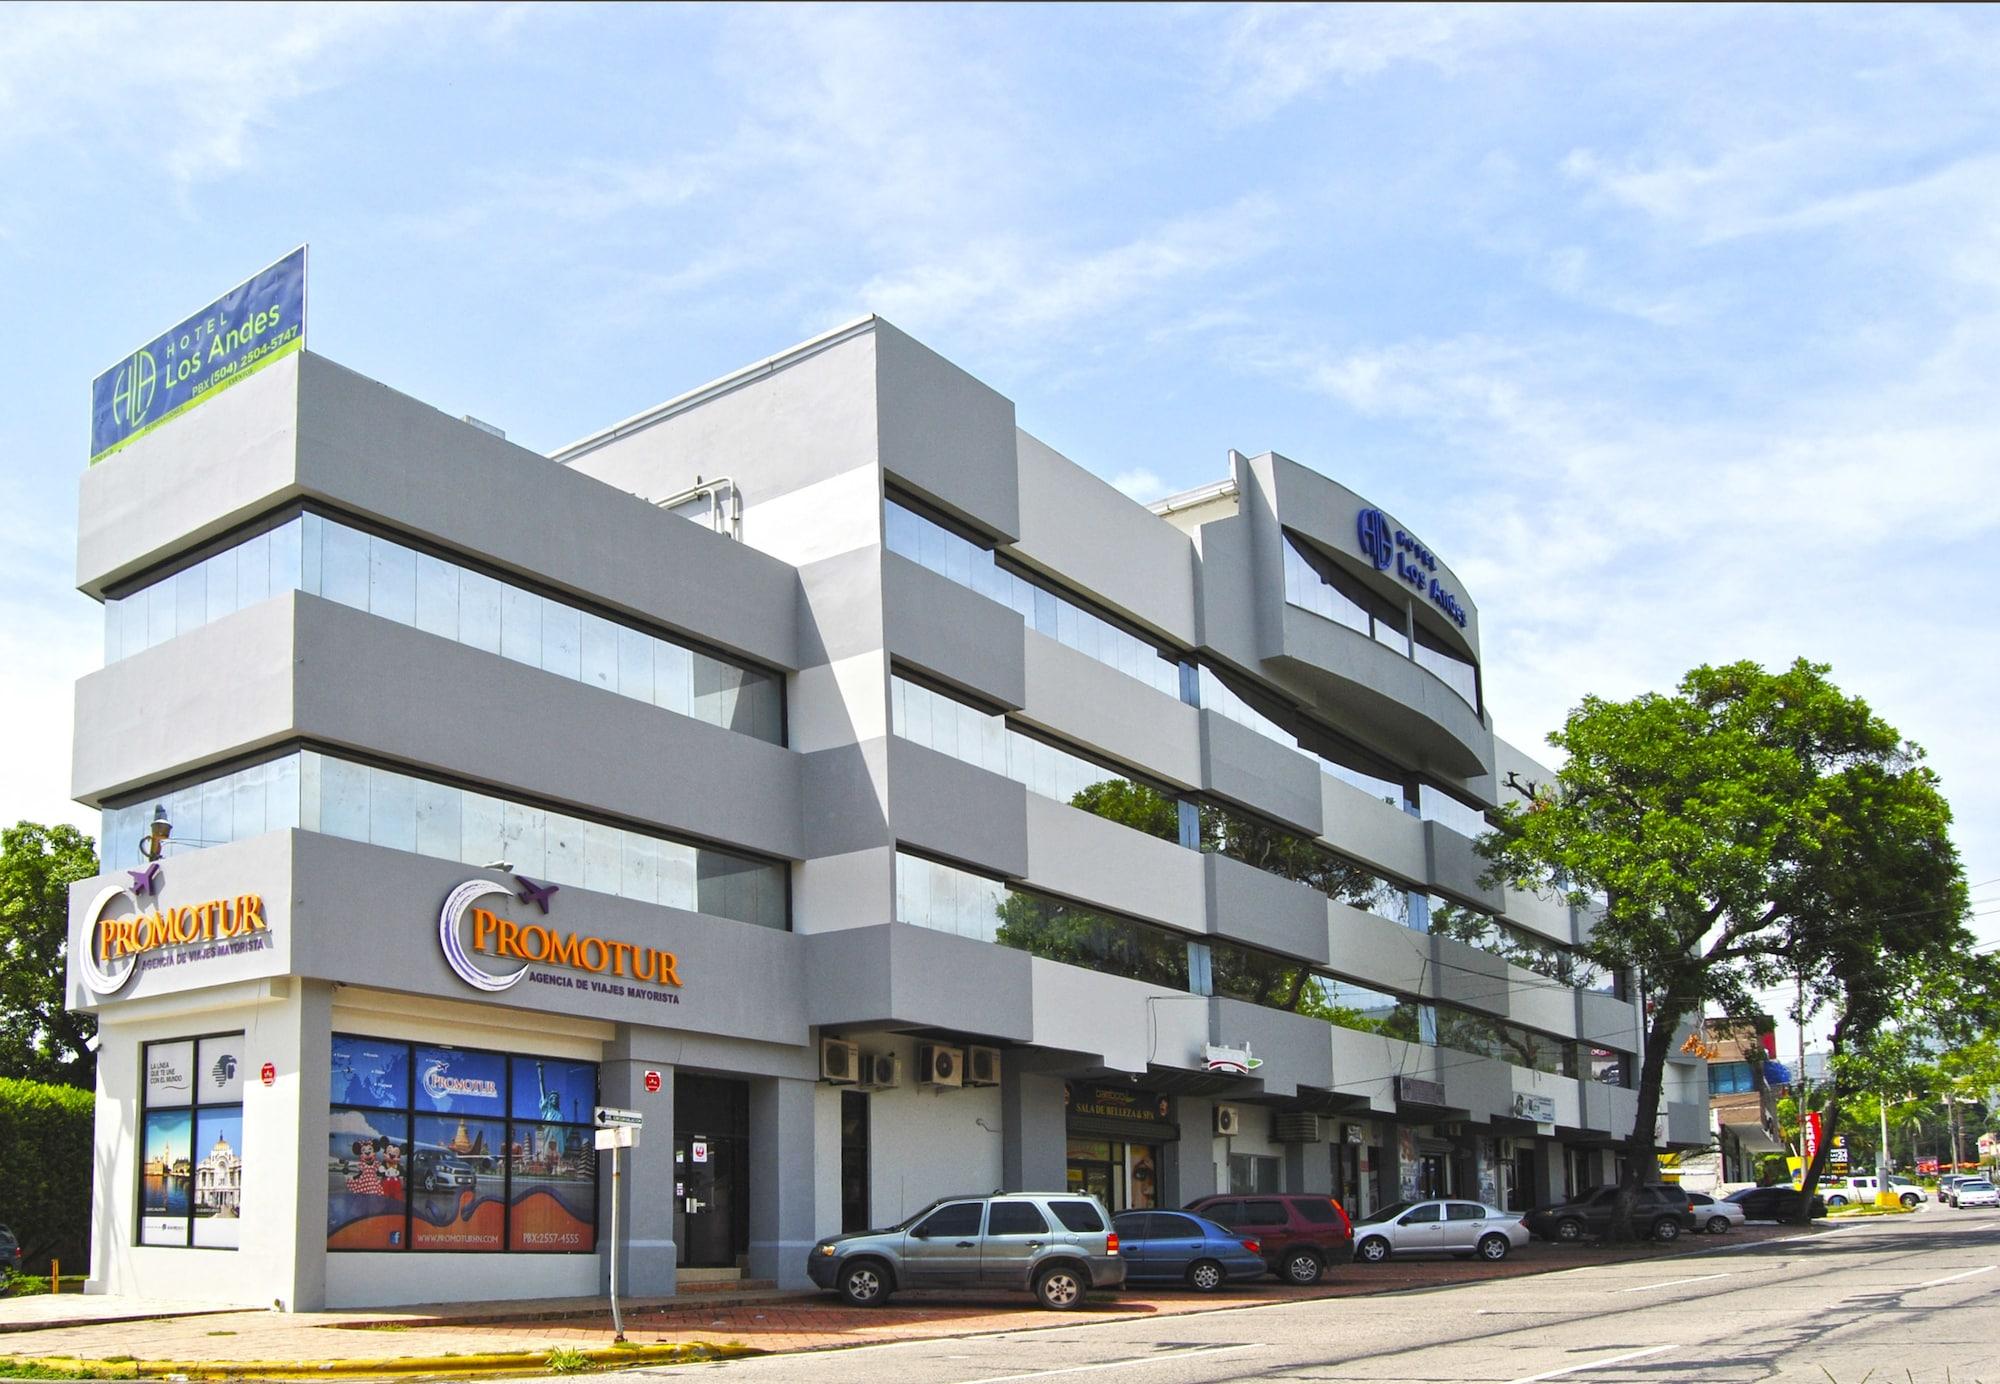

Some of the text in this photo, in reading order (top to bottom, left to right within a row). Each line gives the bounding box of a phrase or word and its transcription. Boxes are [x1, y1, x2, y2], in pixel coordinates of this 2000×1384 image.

[166, 313, 227, 359] HOTEL
[192, 379, 210, 398] PBX
[211, 361, 237, 386] (504)
[240, 324, 299, 368] 2504-5747
[207, 304, 280, 363] Andes
[99, 893, 267, 961] PROMOTUR
[142, 938, 264, 971] AGENCIA DE VIAJES MAYORISTA
[473, 907, 684, 987] PROMOTUR
[529, 971, 680, 1005] AGENCIA DE VIAJES MAYORISTA
